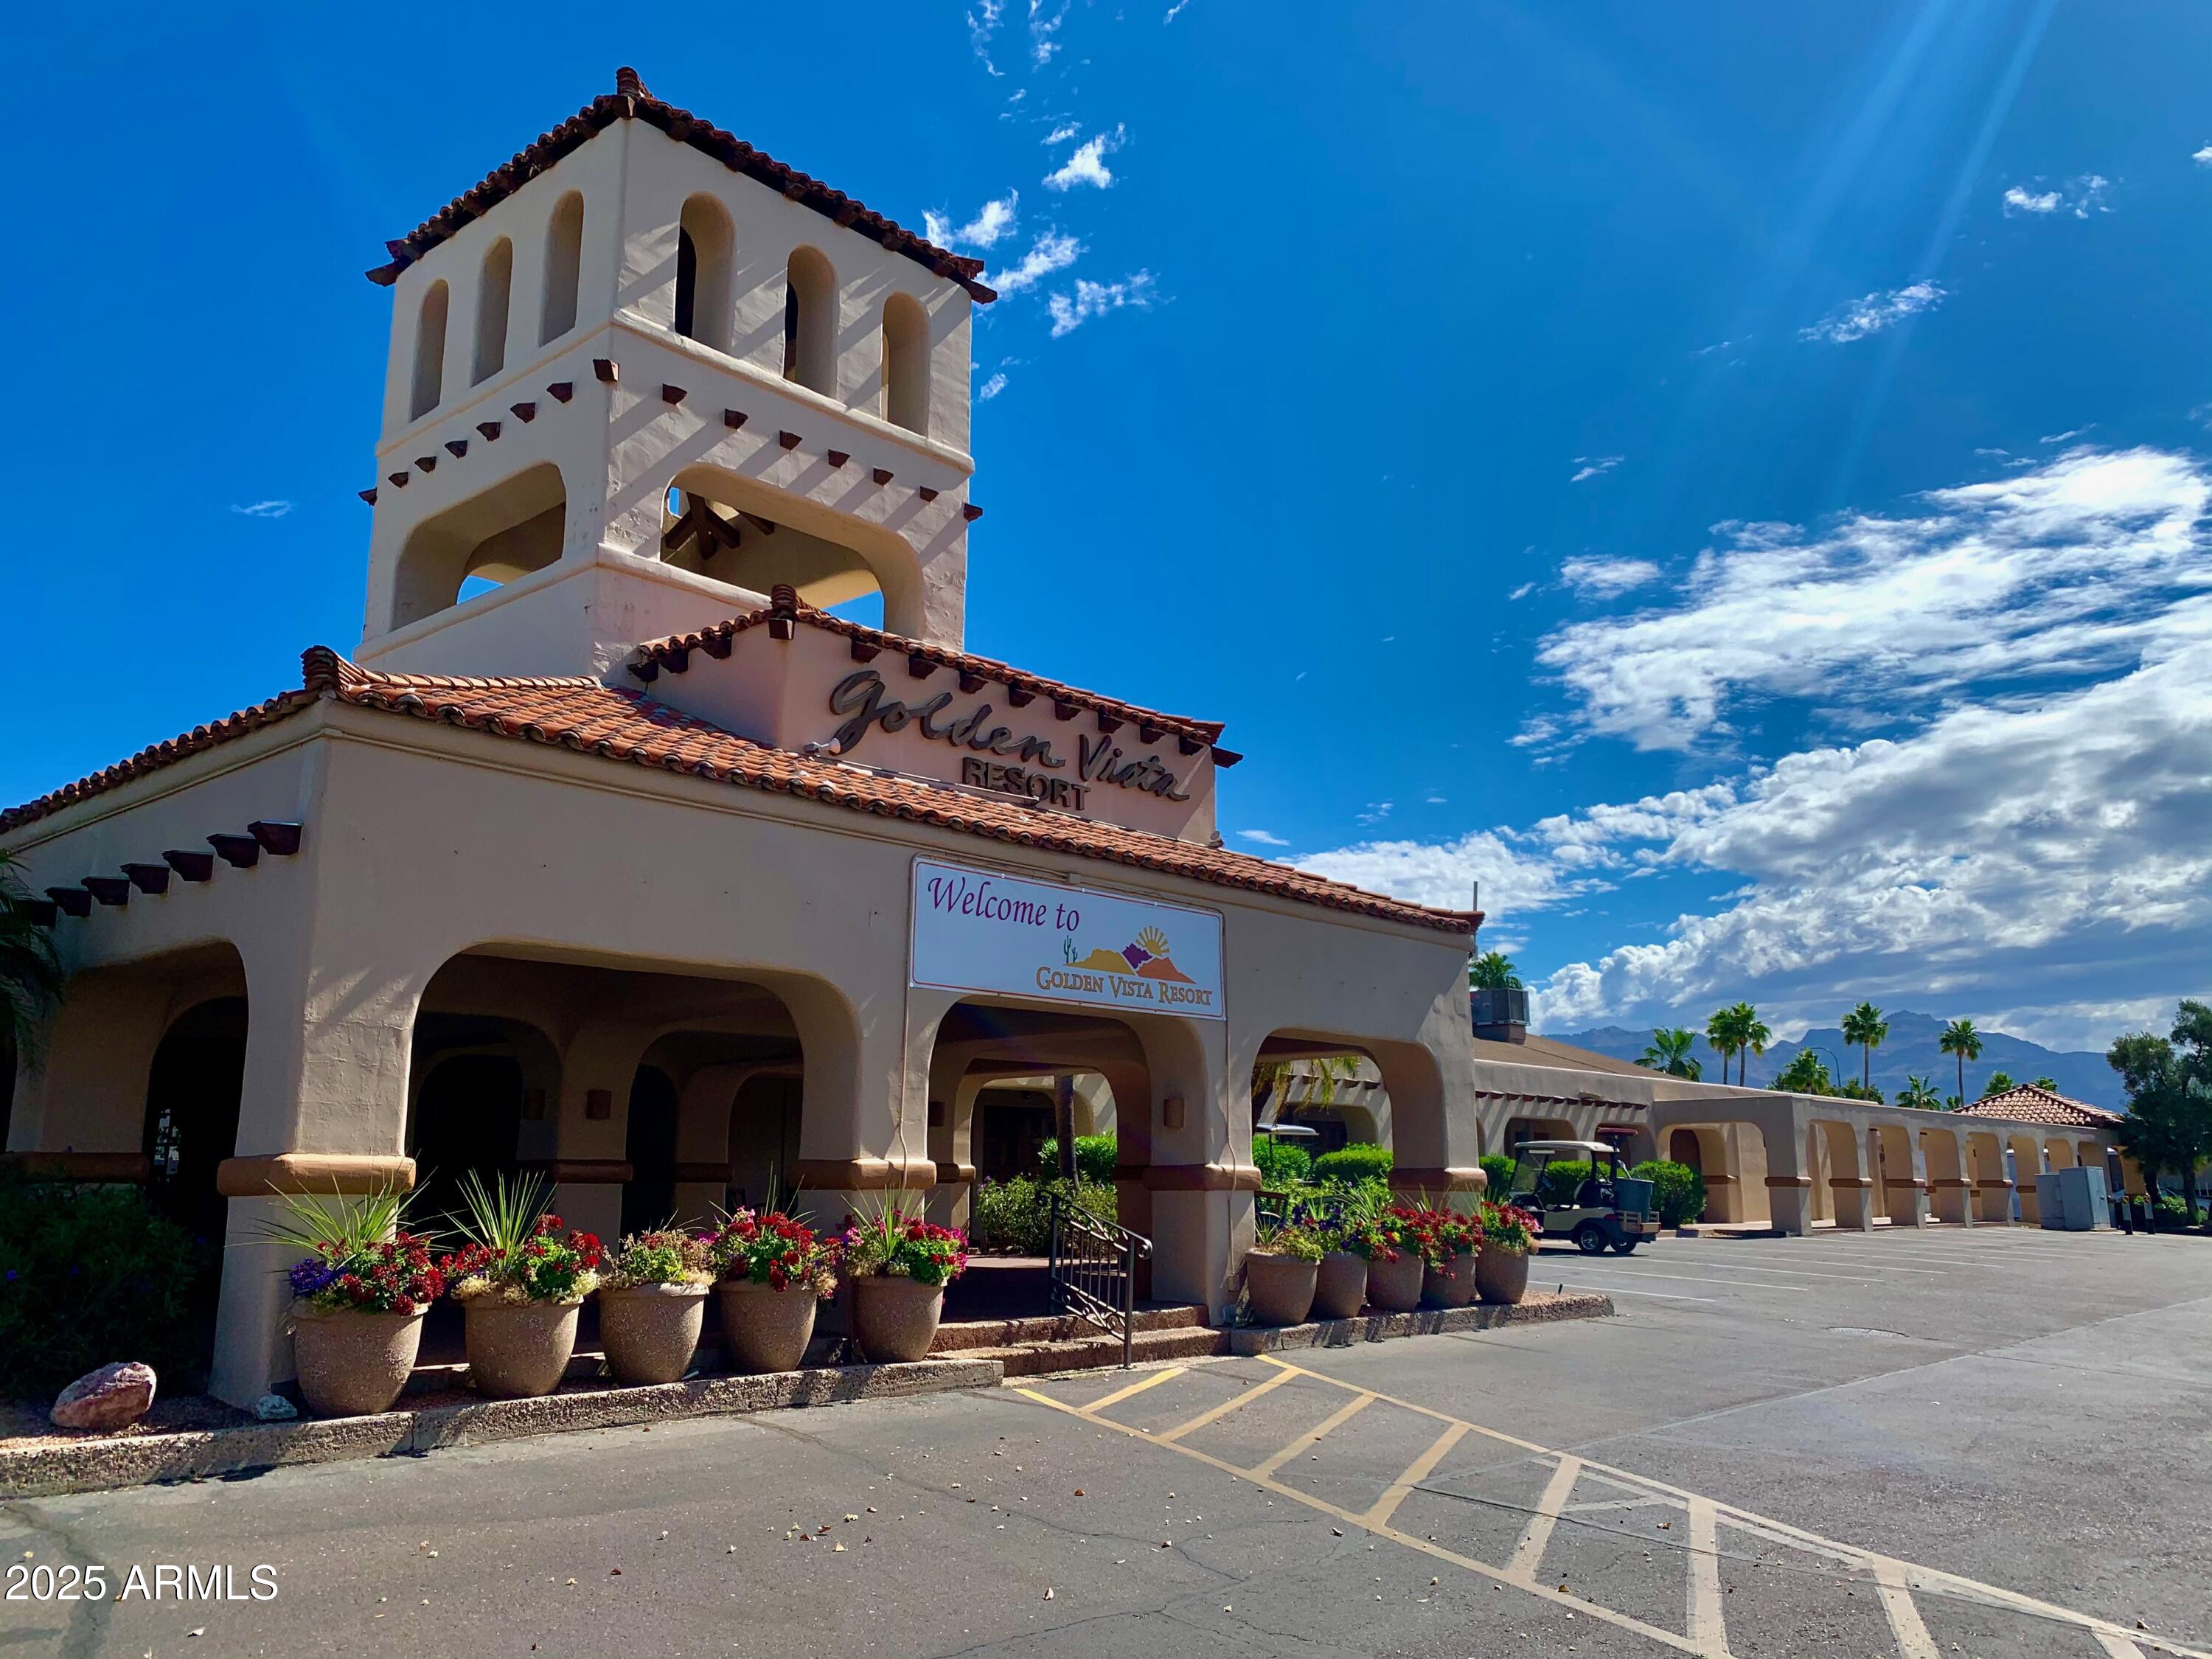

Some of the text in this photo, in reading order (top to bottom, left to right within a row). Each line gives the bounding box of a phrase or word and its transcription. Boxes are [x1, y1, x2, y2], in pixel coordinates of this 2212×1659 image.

[962, 757, 1091, 810] RESORT
[1079, 734, 1190, 801] Vista
[928, 877, 1080, 931] Welcome to
[1036, 967, 1213, 1006] GOLDEN VISTA RESORT
